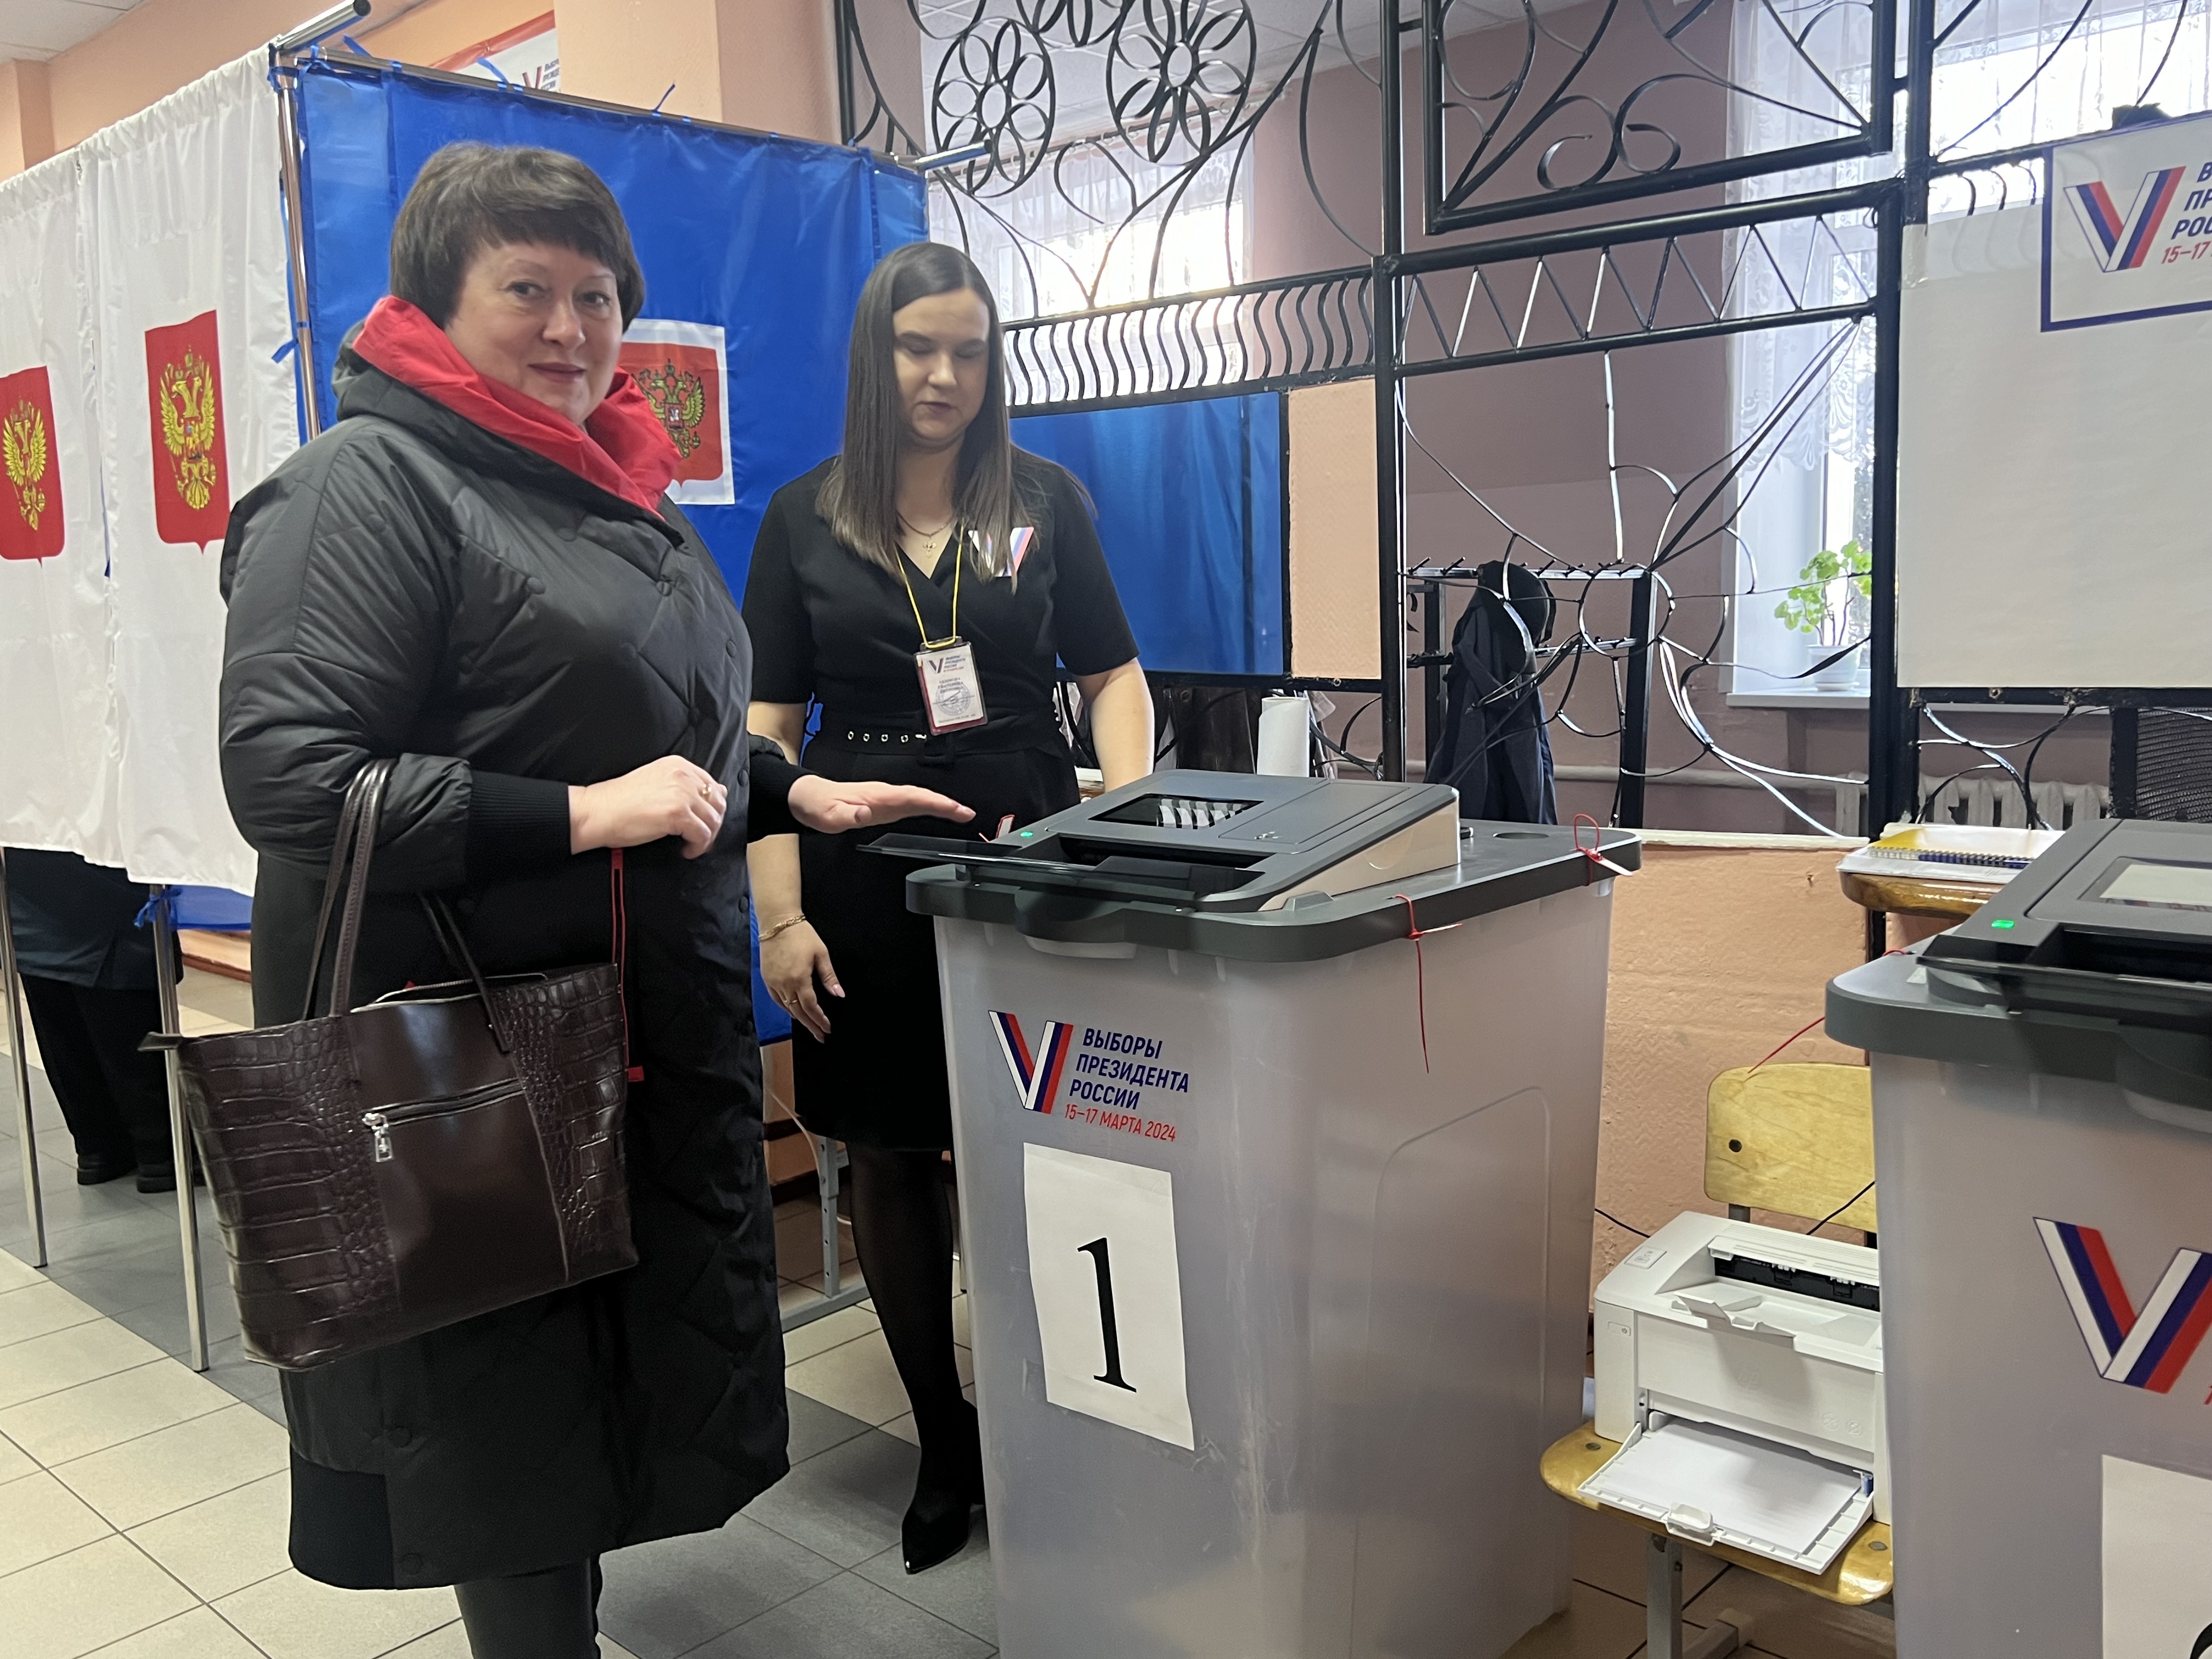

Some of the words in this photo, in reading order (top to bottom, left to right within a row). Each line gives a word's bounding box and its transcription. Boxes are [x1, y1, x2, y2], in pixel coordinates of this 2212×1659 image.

[1082, 1028, 1163, 1059] ВЫБОРЫ
[1076, 1053, 1189, 1093] ПРЕЗИДЕНТА
[1069, 1079, 1140, 1110] РОССИИ
[1099, 1111, 1142, 1135] МАРТА
[1144, 1121, 1176, 1142] 2024
[1077, 1237, 1137, 1393] 1
